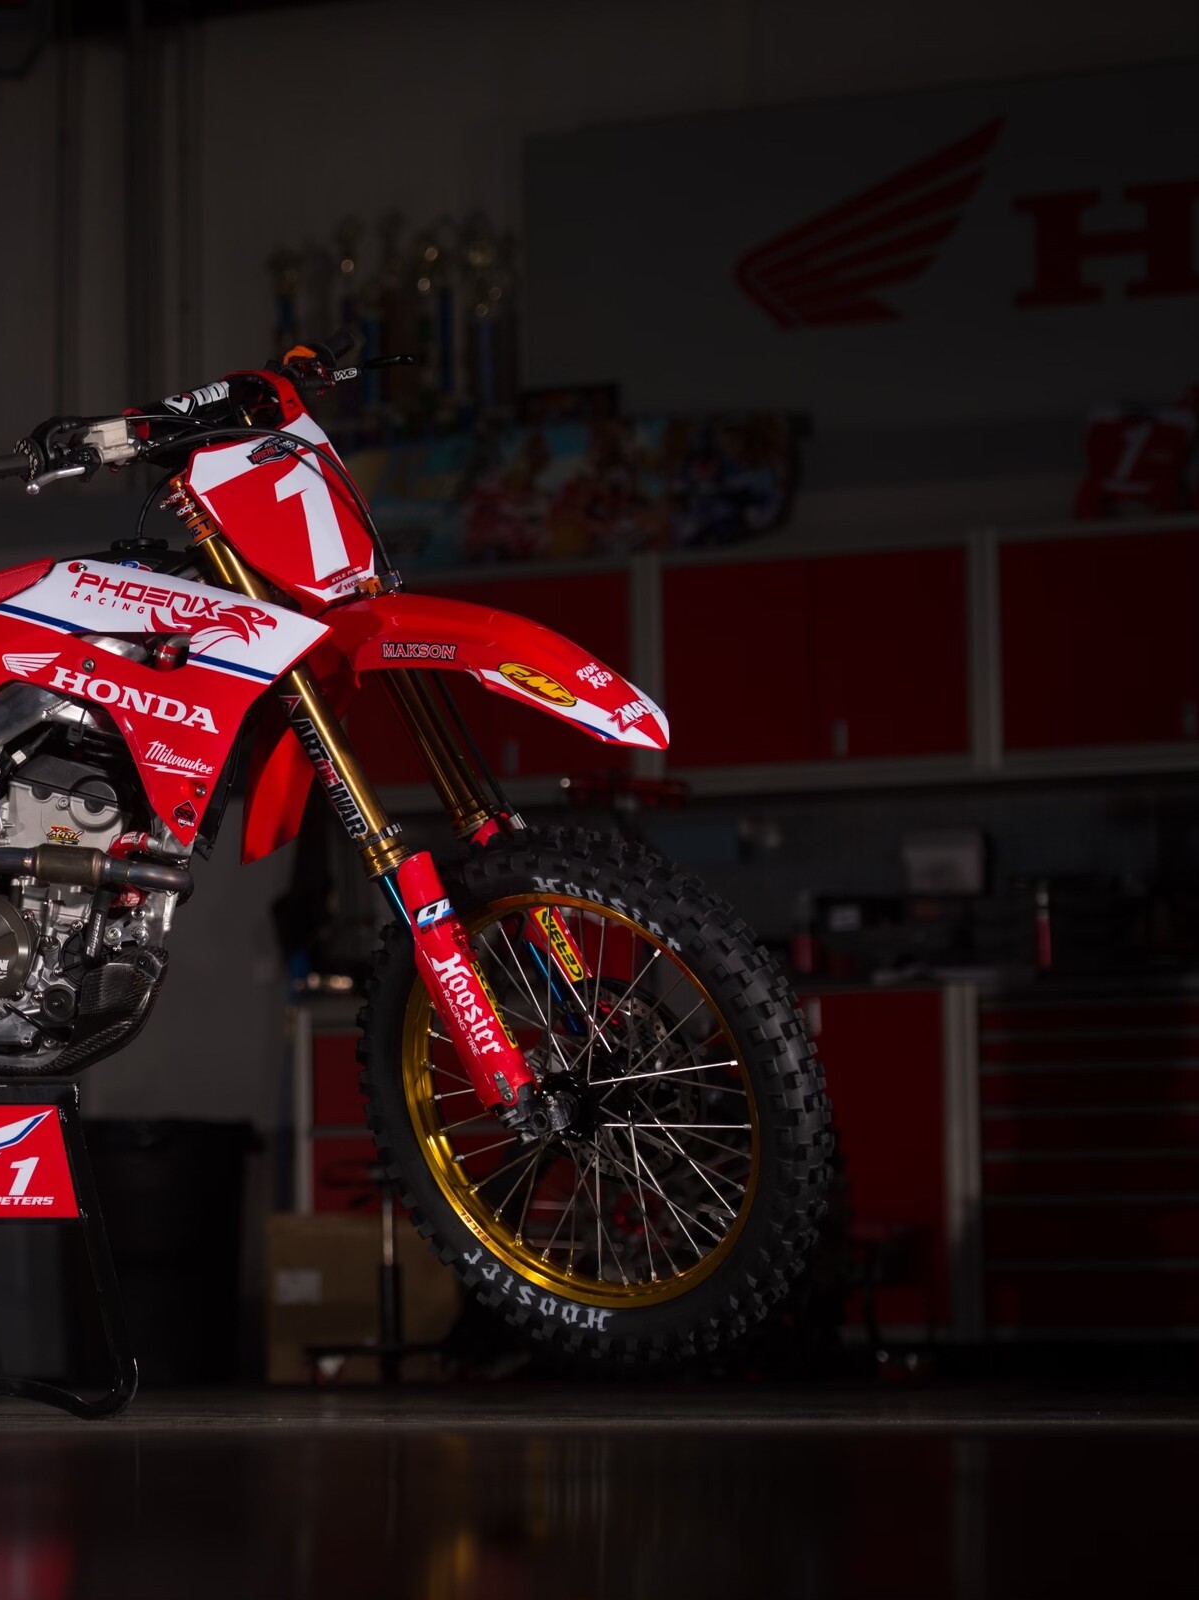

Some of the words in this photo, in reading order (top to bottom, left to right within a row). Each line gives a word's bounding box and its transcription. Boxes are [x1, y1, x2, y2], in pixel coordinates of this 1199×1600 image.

[274, 451, 351, 582] 1
[70, 590, 146, 615] RACING
[74, 571, 222, 618] PHOENIX
[382, 643, 457, 660] MAKSON
[576, 662, 600, 681] RIDE
[49, 665, 220, 735] HONDA
[500, 664, 579, 705] FMF
[588, 671, 613, 689] RED
[145, 740, 214, 776] Milwaukee
[431, 951, 502, 1055] Hoosier
[442, 989, 468, 1032] RACING
[466, 1033, 481, 1057] TIRE
[10, 1157, 40, 1196] 1
[463, 1248, 615, 1332] Hoosier
